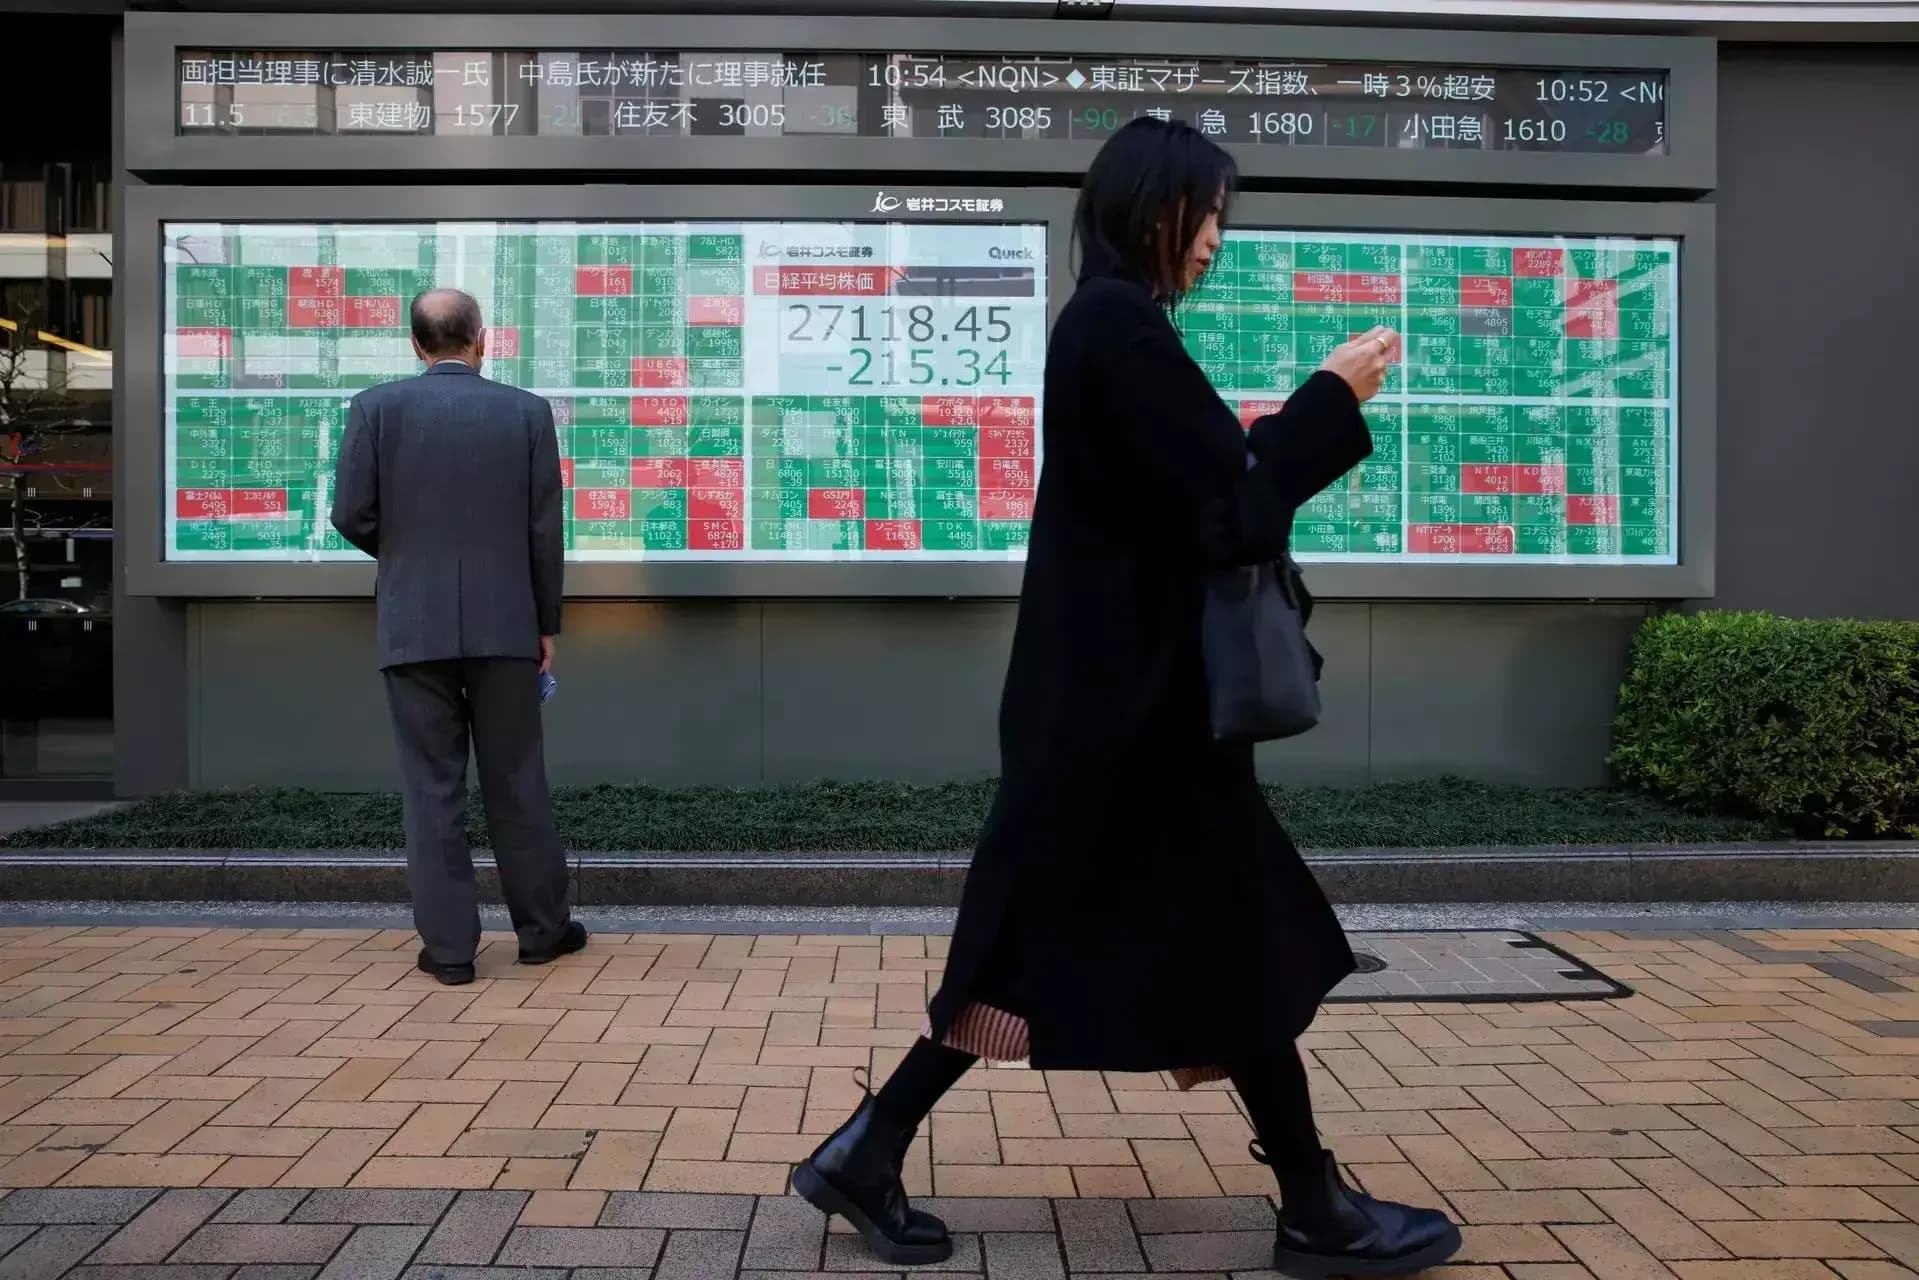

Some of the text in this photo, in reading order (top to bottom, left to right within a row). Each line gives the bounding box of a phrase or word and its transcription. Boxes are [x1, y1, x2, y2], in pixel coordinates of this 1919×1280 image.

[182, 60, 488, 87] 画担当理事に清水誠一氏
[519, 61, 827, 88] 中島氏が新たに理事就任
[869, 65, 946, 88] 10:54
[1536, 80, 1608, 102] 10:52
[1620, 81, 1663, 103] <N
[185, 104, 244, 126] 11.5
[350, 101, 429, 129] 東建物
[454, 104, 519, 127] 1577
[614, 101, 698, 128] 住友不
[719, 104, 785, 127] 3005
[986, 106, 1051, 129] 3085
[1073, 108, 1119, 130] -90
[1249, 113, 1312, 135] 1680
[1333, 114, 1375, 136] -17
[1404, 115, 1482, 141] 小田急
[1504, 120, 1566, 141] 1610
[1584, 121, 1629, 142] -28
[906, 199, 1004, 212] 岩井コスモ証券
[764, 272, 874, 290] 日経平均株価
[788, 304, 1012, 342] 27118.45
[826, 349, 1012, 386] -215.34
